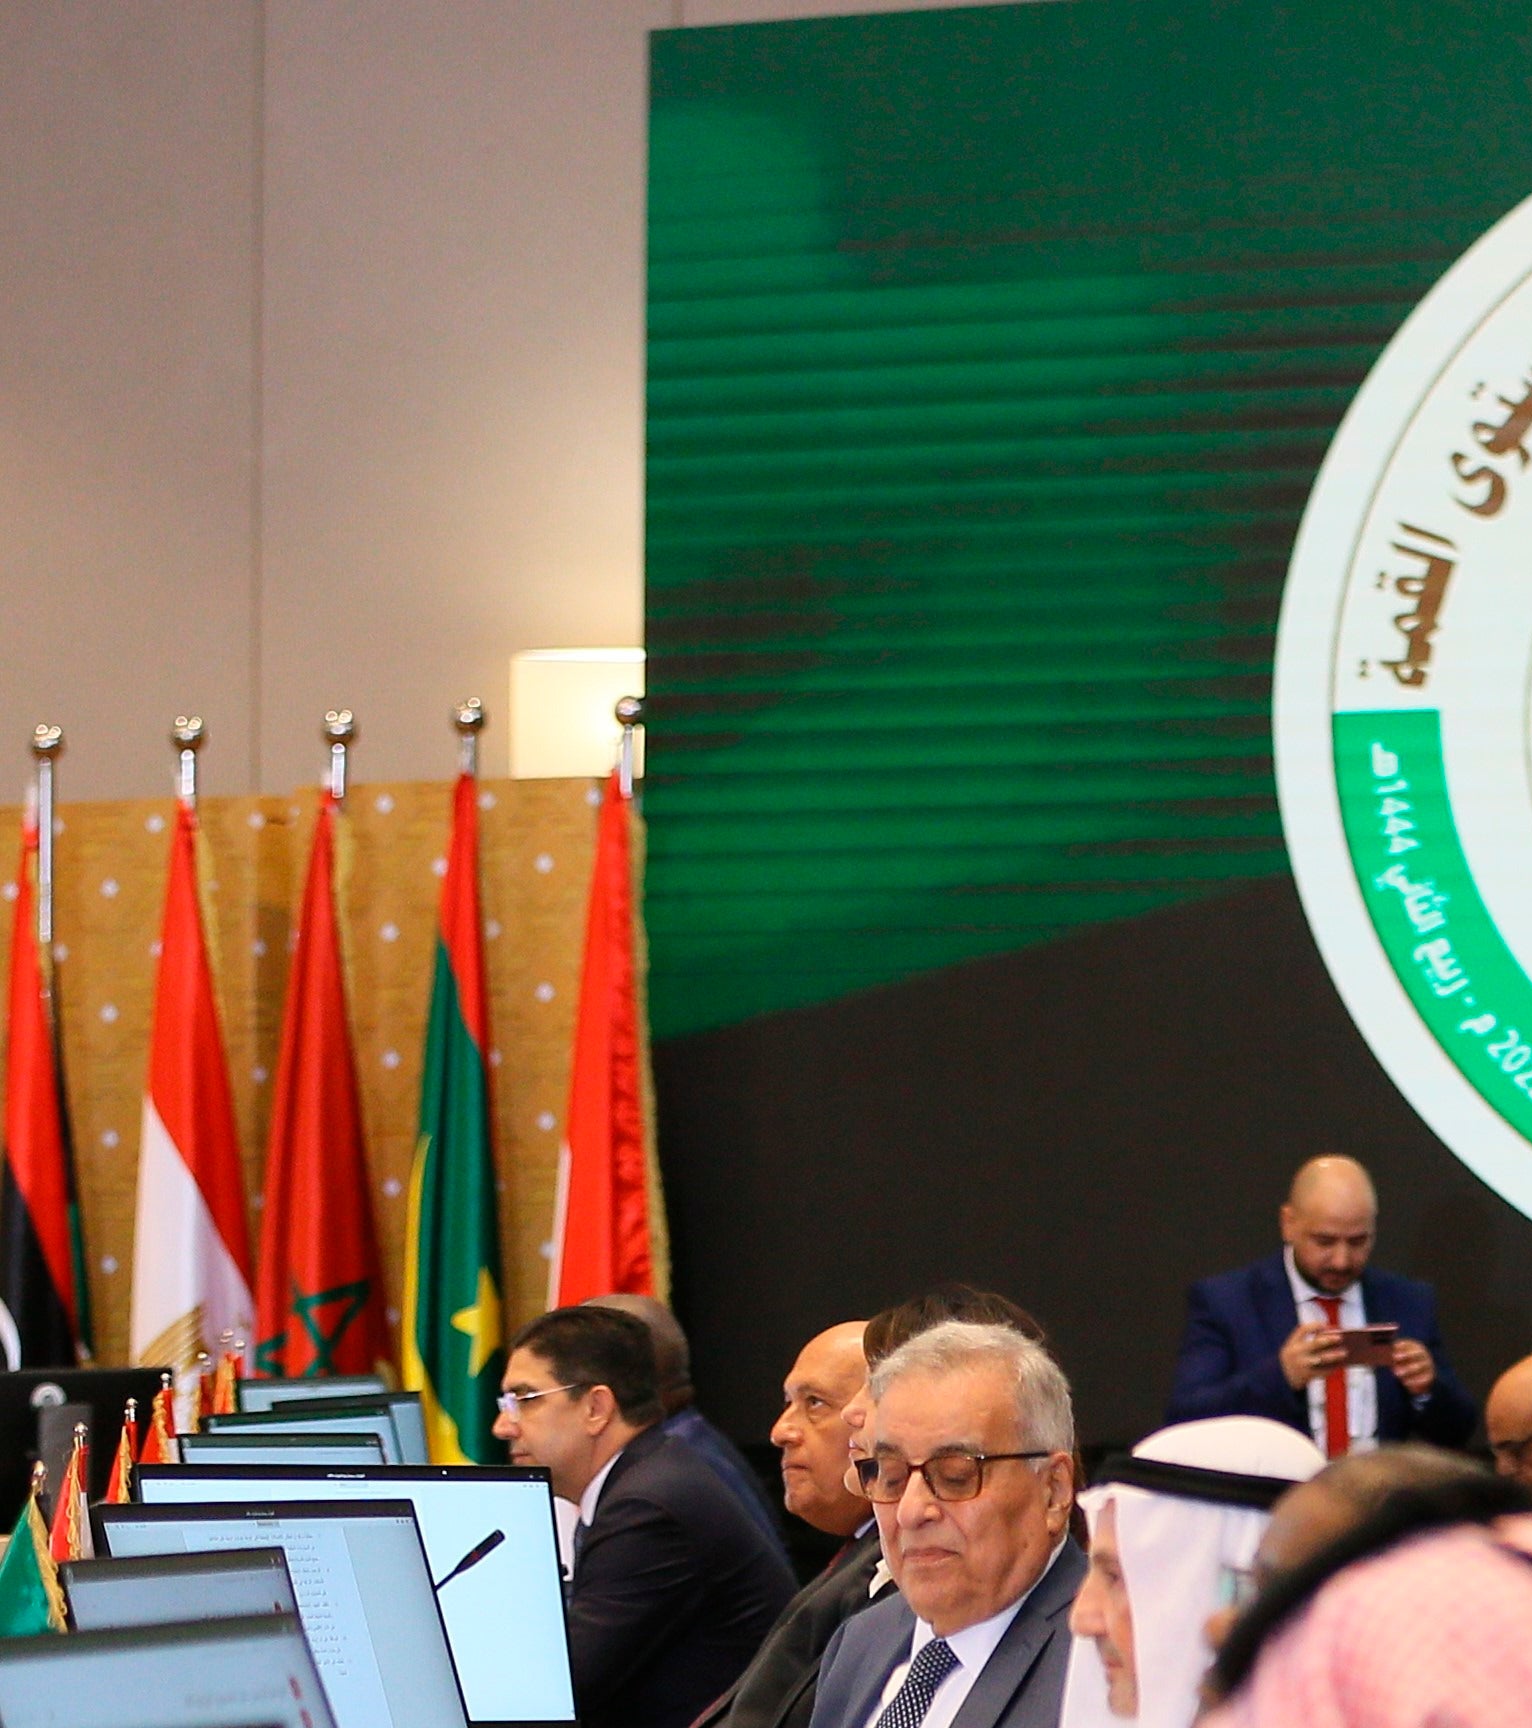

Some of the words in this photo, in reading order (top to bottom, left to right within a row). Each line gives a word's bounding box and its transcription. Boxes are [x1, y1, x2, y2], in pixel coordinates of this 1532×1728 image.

[1360, 522, 1456, 687] القمة
[1414, 938, 1468, 996] ربيع
[1457, 1011, 1498, 1035] م
